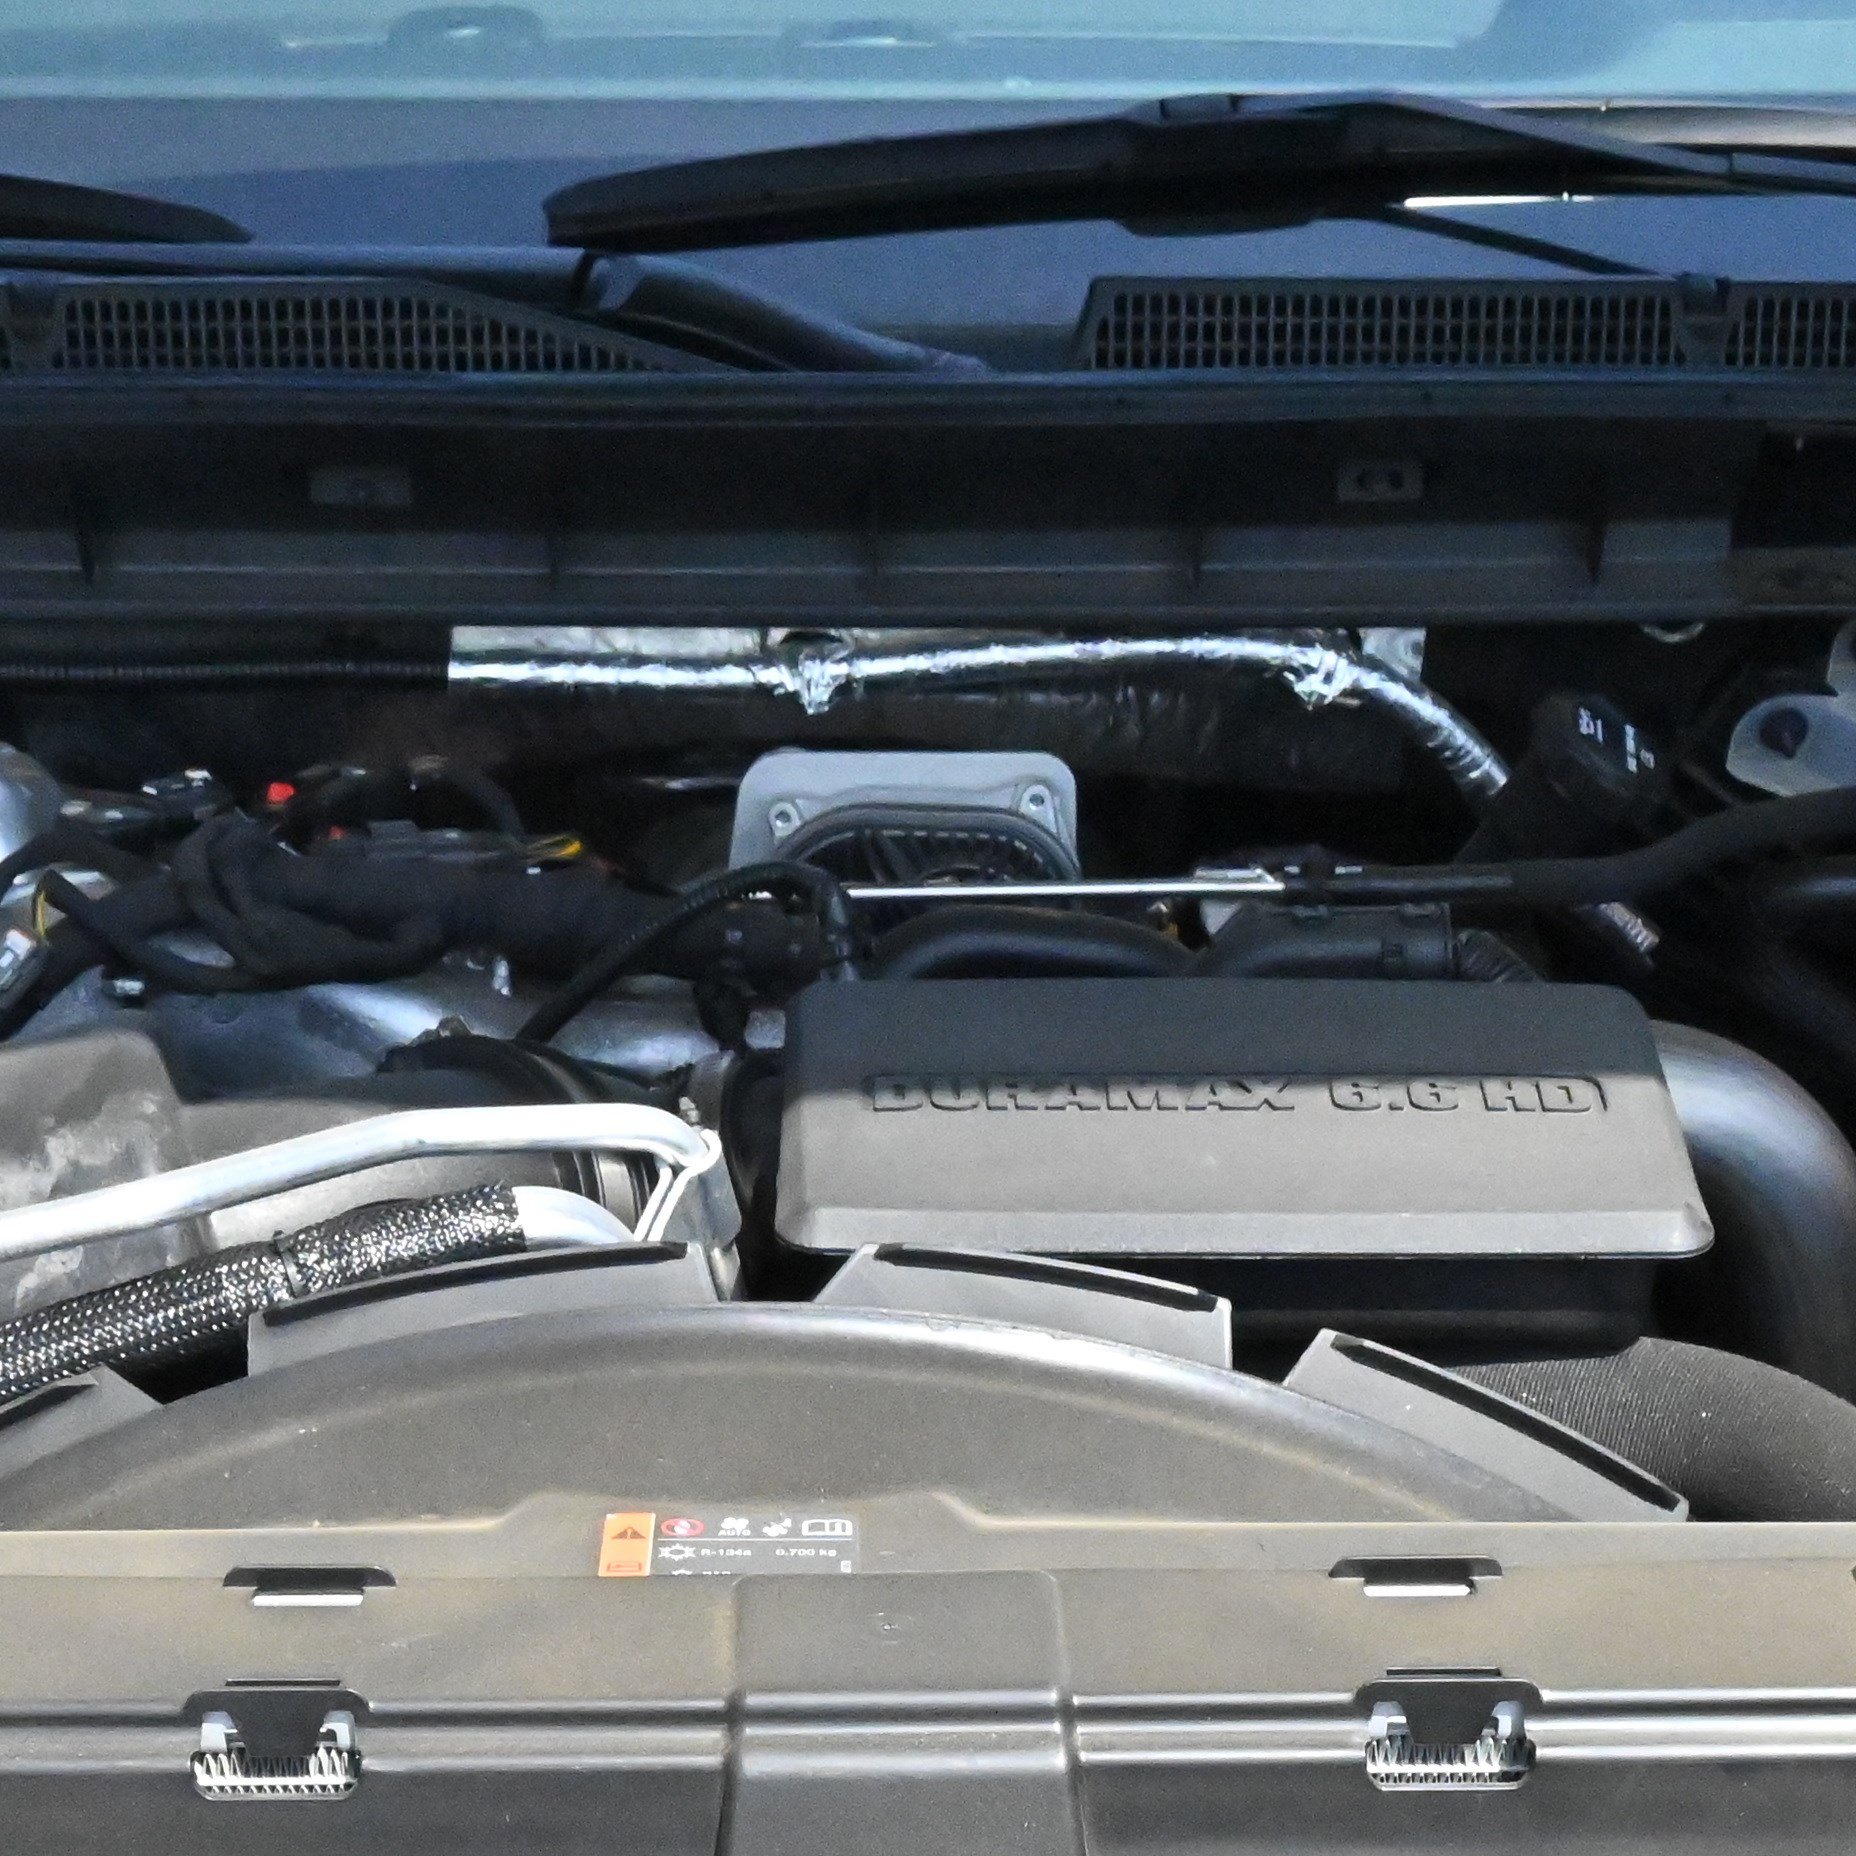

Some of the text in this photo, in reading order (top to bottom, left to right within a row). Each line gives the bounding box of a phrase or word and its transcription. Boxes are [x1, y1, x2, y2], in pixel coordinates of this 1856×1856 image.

[871, 1073, 1596, 1113] DURAMAX 6.6 HD
[700, 1548, 837, 1558] R-134a 0.700 kg
